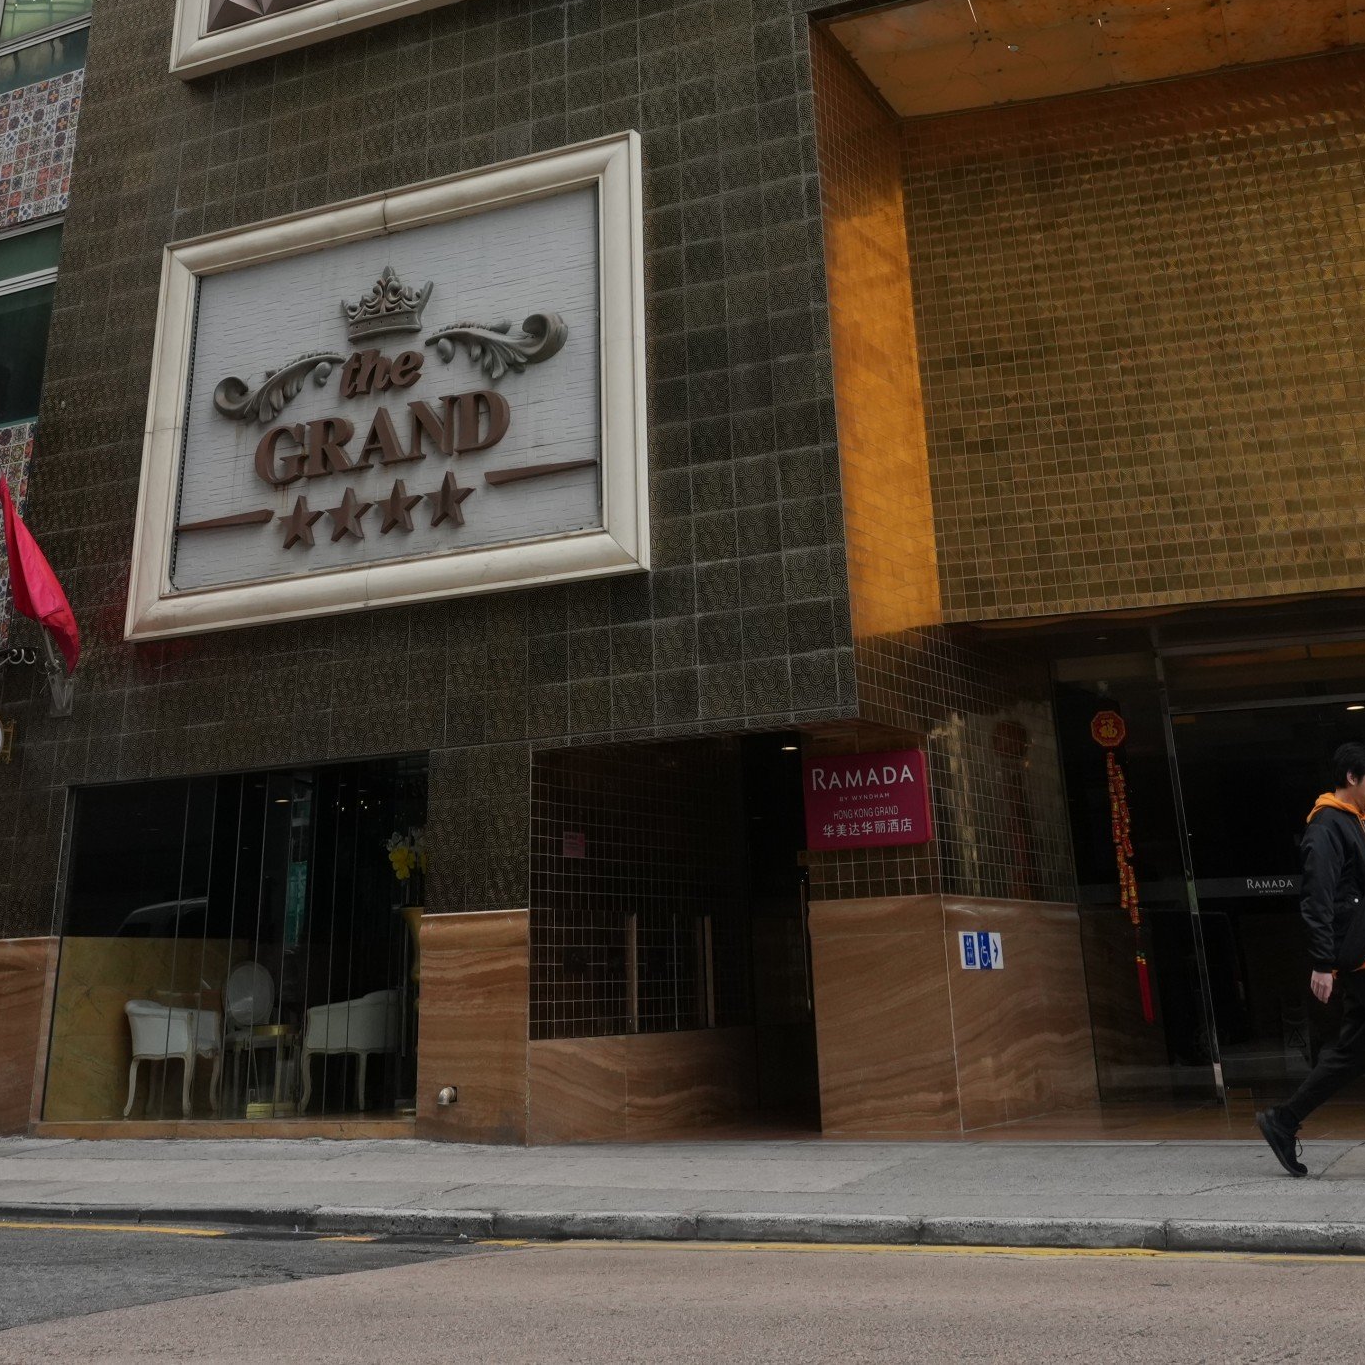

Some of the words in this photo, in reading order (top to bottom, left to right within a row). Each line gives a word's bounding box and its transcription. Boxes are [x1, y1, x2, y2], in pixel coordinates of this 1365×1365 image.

[340, 349, 424, 399] the
[254, 390, 510, 487] GRAND
[812, 764, 915, 791] RAMADA
[852, 792, 890, 801] WYNDHAM
[833, 808, 853, 820] HONG
[854, 807, 874, 818] KONG
[875, 805, 899, 817] GRAND
[822, 818, 913, 838] 华美达华丽酒店
[1246, 878, 1294, 890] RAMADA
